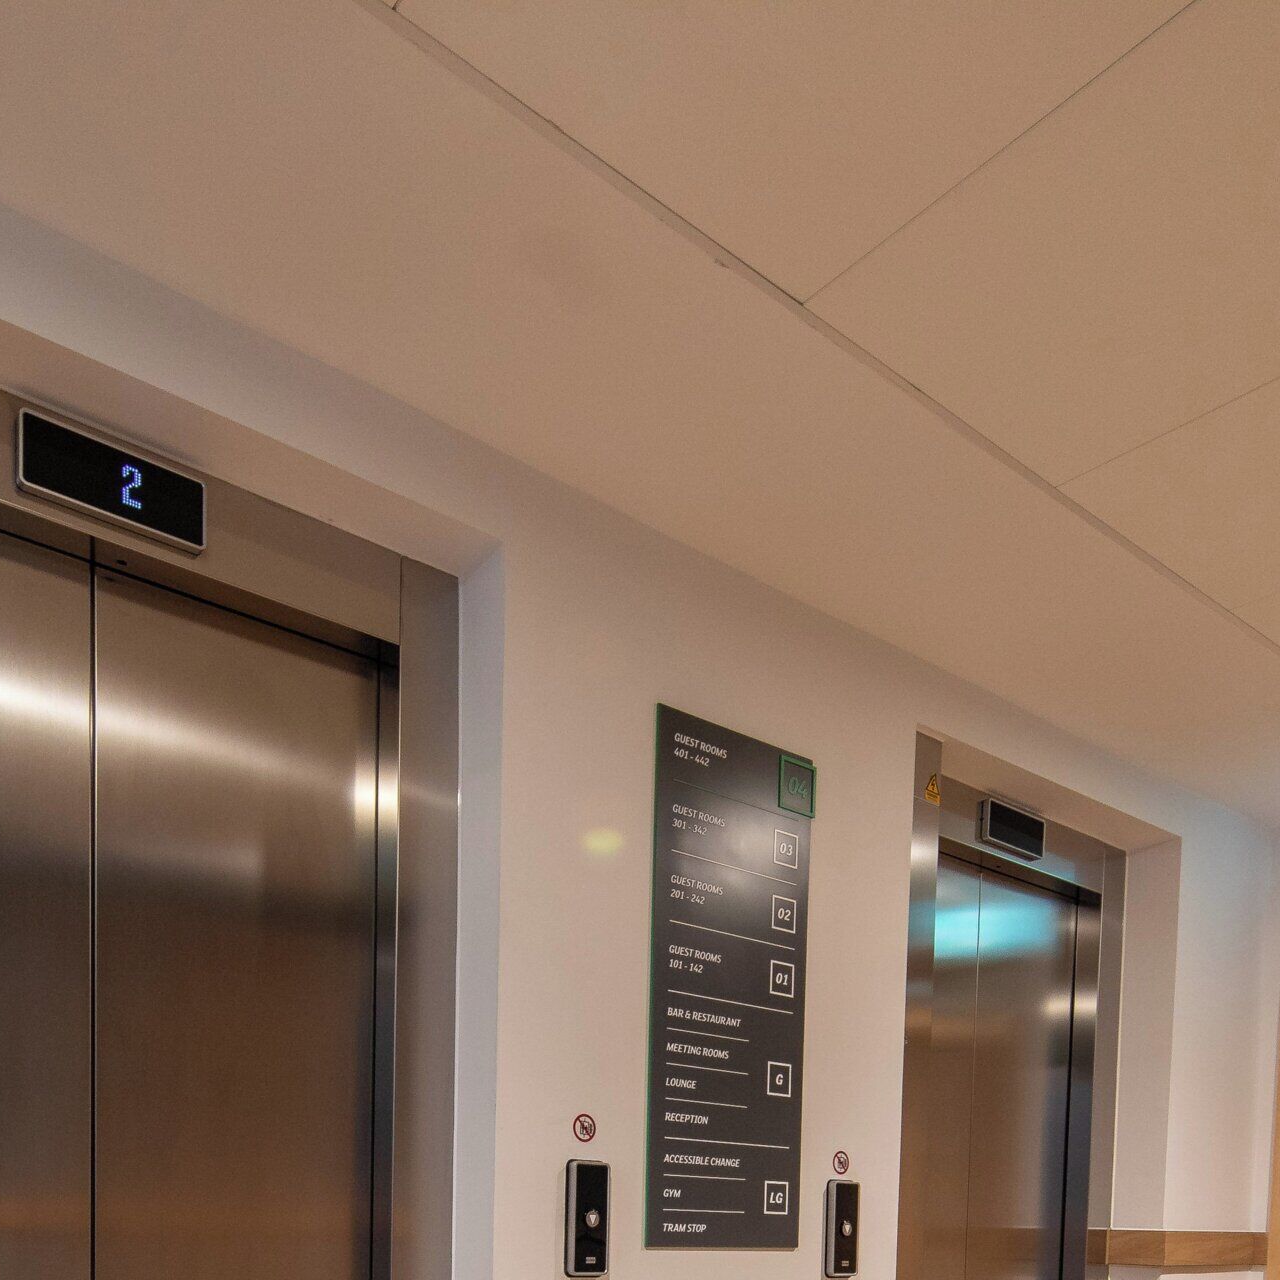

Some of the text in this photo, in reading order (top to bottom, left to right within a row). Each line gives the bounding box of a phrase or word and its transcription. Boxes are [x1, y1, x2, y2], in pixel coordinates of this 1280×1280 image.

[122, 464, 142, 510] 2
[674, 732, 728, 758] GUEST ROOMS
[674, 748, 690, 760] 401
[694, 754, 710, 767] 442
[788, 776, 808, 798] 04
[672, 804, 726, 827] GUEST ROOMS
[672, 818, 687, 830] 301
[692, 824, 707, 836] 342
[780, 842, 792, 856] 03
[671, 874, 724, 896] GUEST ROOMS
[671, 888, 685, 900] 201
[691, 892, 705, 904] 242
[778, 907, 791, 921] 02
[669, 945, 722, 964] GUEST ROOMS
[669, 959, 682, 970] 101
[690, 963, 704, 974] 142
[776, 973, 788, 986] 01
[668, 1007, 741, 1028] BAR & RESTAURANT
[666, 1042, 729, 1059] MEETING ROOMS
[666, 1078, 696, 1090] LOUNGE
[776, 1074, 783, 1086] G
[665, 1112, 708, 1124] RECEPTION
[664, 1154, 740, 1168] ACCESSIBLE CHANGE
[664, 1188, 681, 1198] GYM
[770, 1192, 783, 1204] LG
[663, 1223, 706, 1232] TRAM STOP
